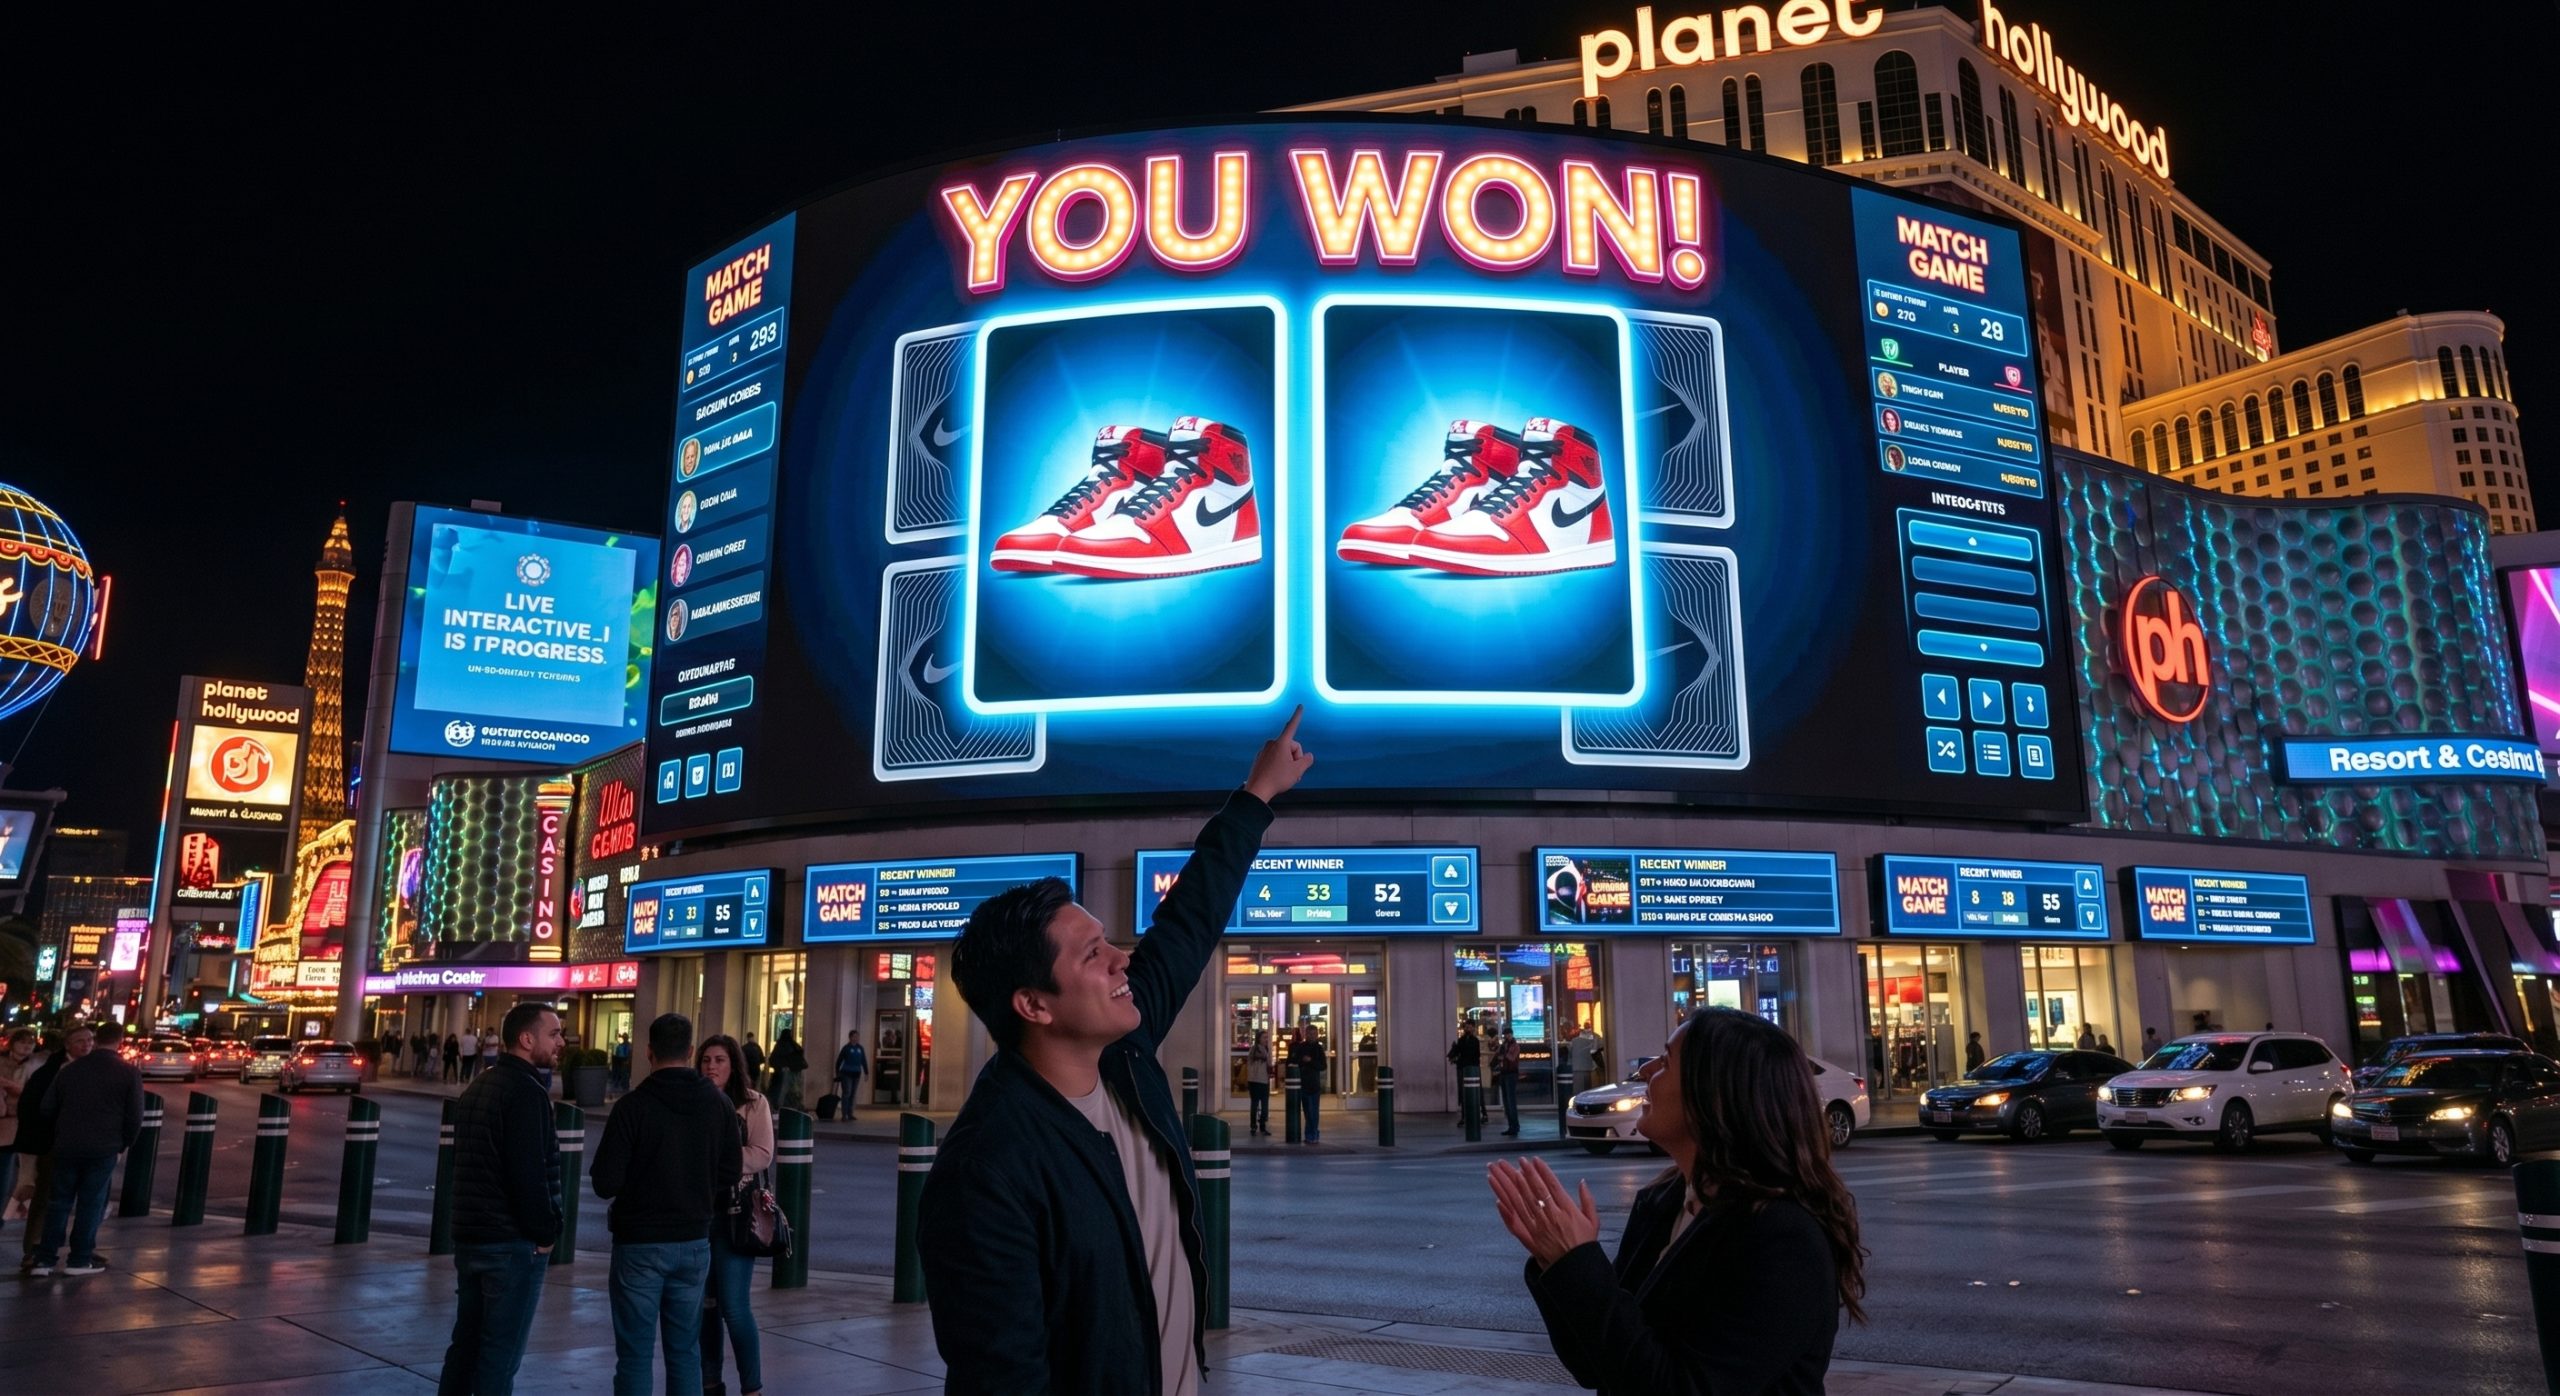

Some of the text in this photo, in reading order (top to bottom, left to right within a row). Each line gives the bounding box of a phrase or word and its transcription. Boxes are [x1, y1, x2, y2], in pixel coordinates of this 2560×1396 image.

[1580, 0, 2171, 180] planet hollywood
[942, 148, 1707, 294] YOU WON!
[1896, 215, 1989, 265] MATCH
[704, 243, 771, 302] MATCH
[1908, 249, 1986, 294] GAME
[707, 276, 763, 326] GAME
[749, 321, 777, 352] 293
[1952, 322, 1960, 334] 3
[1938, 362, 1970, 378] PLAYER
[504, 592, 555, 614] LIVE
[443, 632, 466, 650] IS
[2135, 591, 2209, 706] ph
[203, 680, 268, 700] planet
[202, 701, 300, 724] hollywood
[2329, 746, 2433, 772] Resort
[2438, 744, 2462, 768] &
[1295, 858, 1344, 870] WINNER
[1640, 859, 1681, 869] RECENT
[535, 814, 559, 940] CASINO
[1897, 875, 1948, 896] MATCH
[817, 883, 866, 905] MATCH
[1258, 883, 1401, 902] 4 33 52
[1971, 890, 1980, 905] 8
[2042, 893, 2061, 911] 55
[2145, 886, 2186, 906] MATCH
[633, 899, 659, 919] MATCH
[819, 903, 862, 923] GAME
[1902, 896, 1946, 915] GAME
[2150, 905, 2186, 922] GAME
